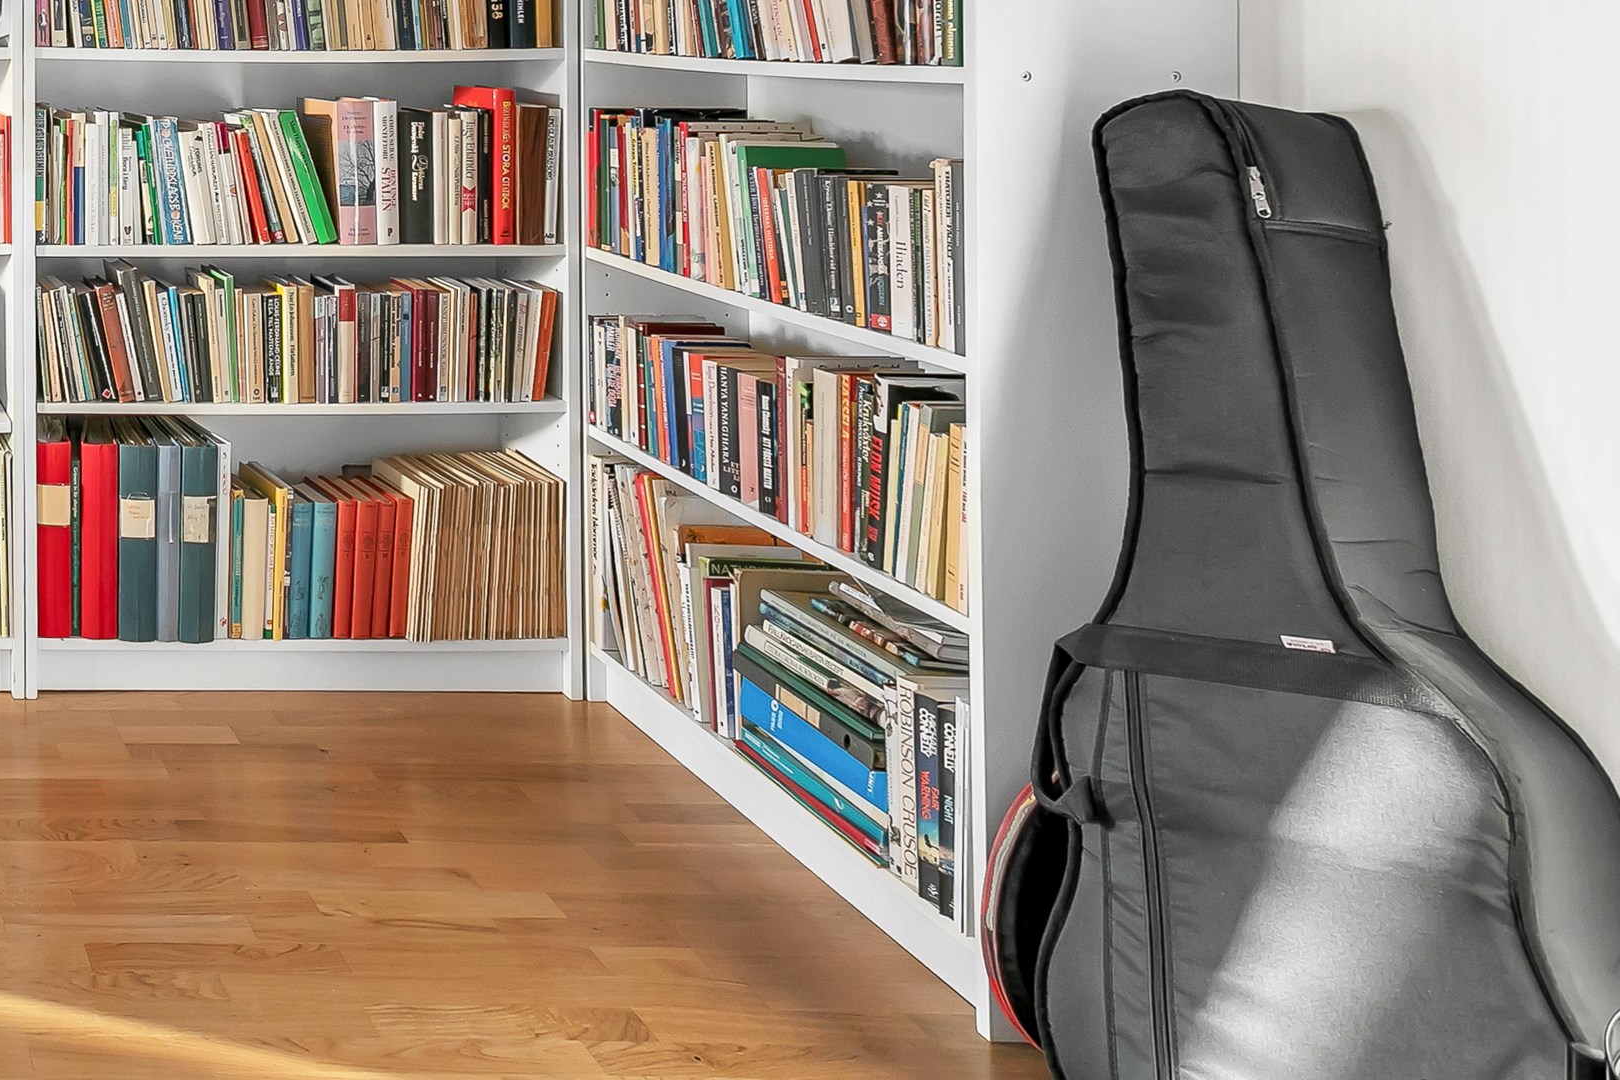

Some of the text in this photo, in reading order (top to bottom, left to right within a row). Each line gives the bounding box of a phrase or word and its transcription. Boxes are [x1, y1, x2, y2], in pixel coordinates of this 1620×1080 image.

[491, 3, 503, 20] 38
[195, 147, 203, 173] FORUMS
[463, 119, 476, 180] Tage Erlander
[502, 144, 511, 175] STORA
[381, 166, 391, 212] STALIN
[712, 197, 720, 228] LARSSON
[762, 197, 774, 260] IDÉERNAS HISTORIA
[895, 241, 907, 289] Iliaden
[161, 297, 172, 332] Chomsky
[440, 295, 449, 359] ERNST BRUNNER
[274, 353, 282, 376] CÉLINE
[720, 366, 730, 464] HANYA YANAGIHARA
[861, 399, 873, 462] Krukväxter
[869, 435, 882, 521] ELON MUSK
[919, 707, 931, 758] CONNELLY
[927, 712, 937, 757] MICHAEL
[899, 684, 918, 880] ROBINSON CRUSOE
[920, 769, 932, 820] WARNING
[944, 721, 956, 825] CONNELLY NIGHT
[931, 785, 940, 811] FAIR
